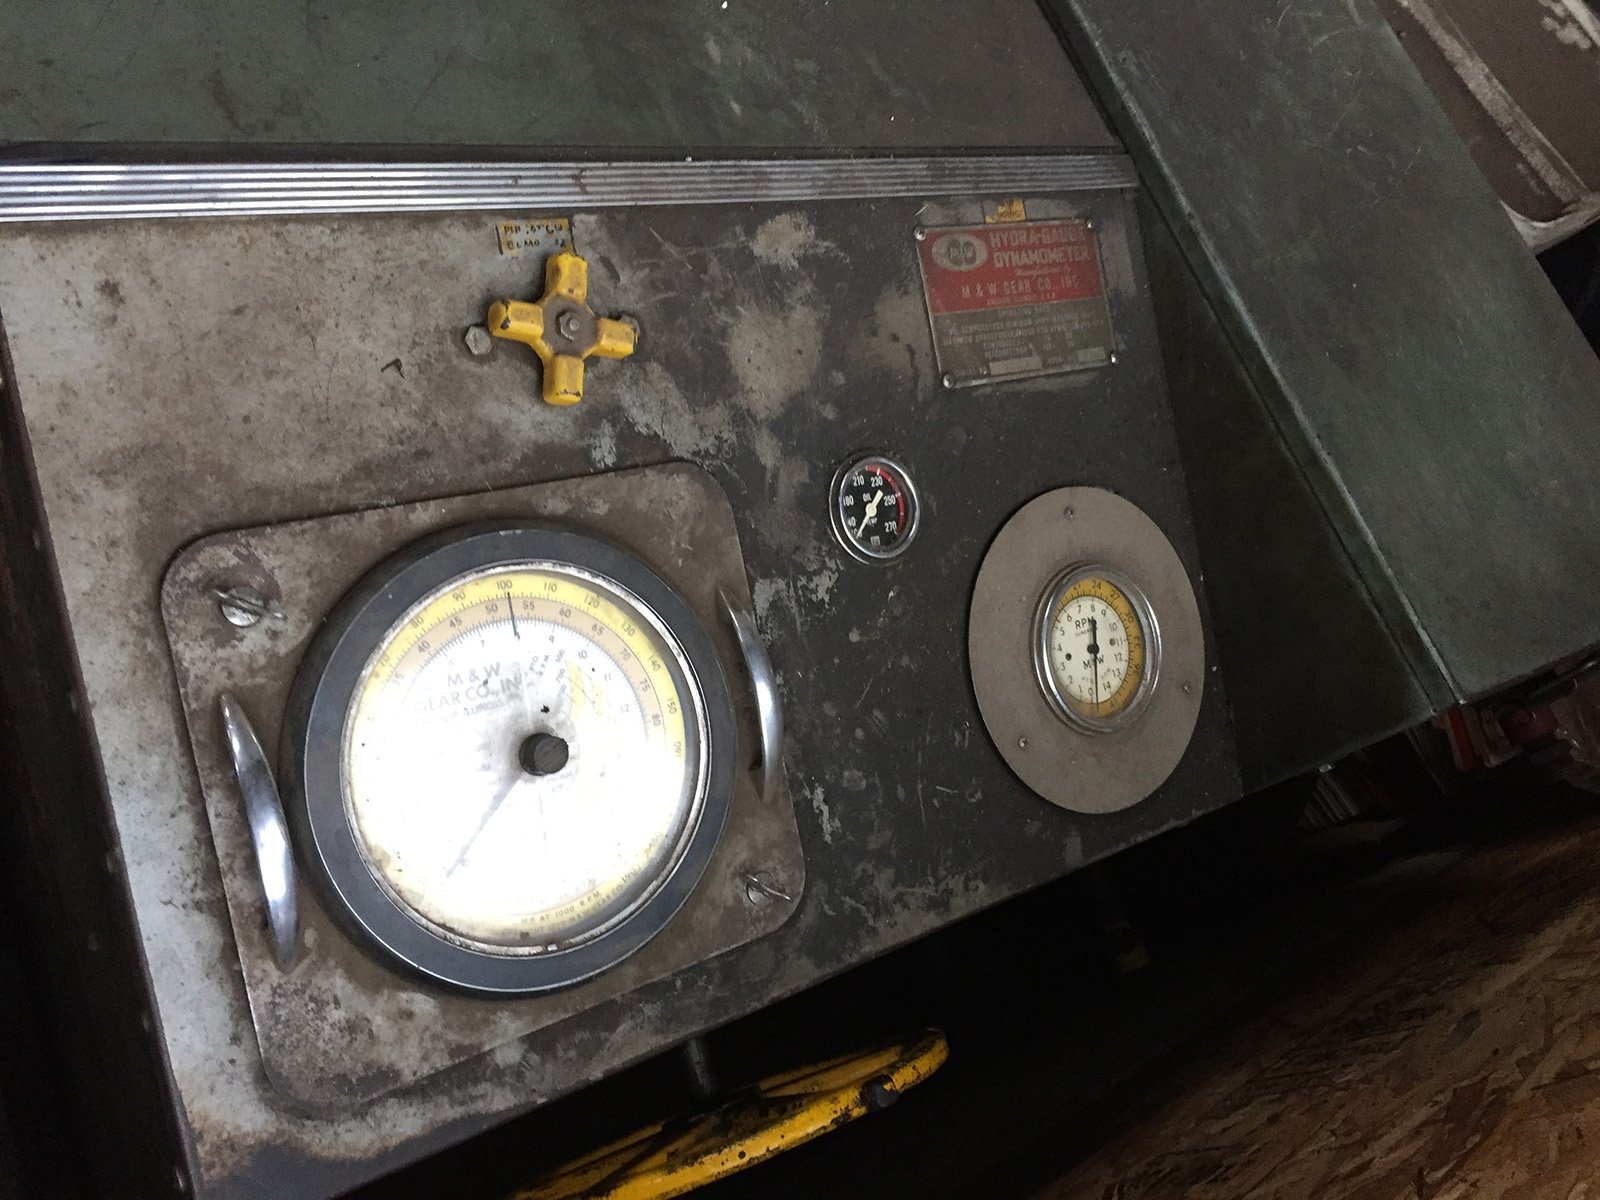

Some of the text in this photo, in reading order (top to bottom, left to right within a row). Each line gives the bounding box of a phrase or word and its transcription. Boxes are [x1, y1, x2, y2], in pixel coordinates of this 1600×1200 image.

[993, 245, 1090, 268] DYNAMOMETER
[1003, 279, 1032, 295] GEAR
[853, 474, 865, 487] 210
[871, 475, 883, 488] 230
[883, 494, 896, 507] 250
[884, 520, 897, 533] 270
[496, 579, 513, 590] 100
[544, 581, 557, 593] 110
[1092, 579, 1102, 590] 24
[452, 591, 466, 601] 90
[584, 594, 600, 609] 120
[485, 602, 498, 614] 50
[522, 600, 535, 610] 55
[1077, 604, 1082, 614] 7
[1090, 604, 1096, 613] 8
[559, 607, 572, 618] 60
[1066, 613, 1073, 622] 6
[1101, 609, 1107, 618] 9
[449, 616, 463, 628] 45
[1074, 616, 1095, 630] RPM
[1108, 622, 1118, 632] 10
[591, 623, 603, 636] 65
[621, 621, 636, 637] 130
[1059, 626, 1065, 636] 5
[417, 639, 431, 653] 40
[1057, 643, 1063, 652] 4
[1115, 637, 1124, 647] 11
[578, 649, 587, 660] 10
[619, 647, 631, 661] 70
[1114, 652, 1123, 662] 12
[647, 654, 661, 672] 140
[1059, 662, 1066, 671] 3
[447, 661, 500, 689] M & W
[604, 672, 612, 682] 11
[1112, 667, 1121, 678] 13
[639, 678, 651, 692] 75
[1067, 675, 1073, 684] 2
[1078, 684, 1083, 694] 1
[1102, 681, 1111, 691] 14
[1087, 687, 1094, 697] 0
[620, 704, 629, 713] 12
[667, 697, 678, 714] 150
[651, 713, 661, 727] 80
[555, 905, 574, 918] 1000
